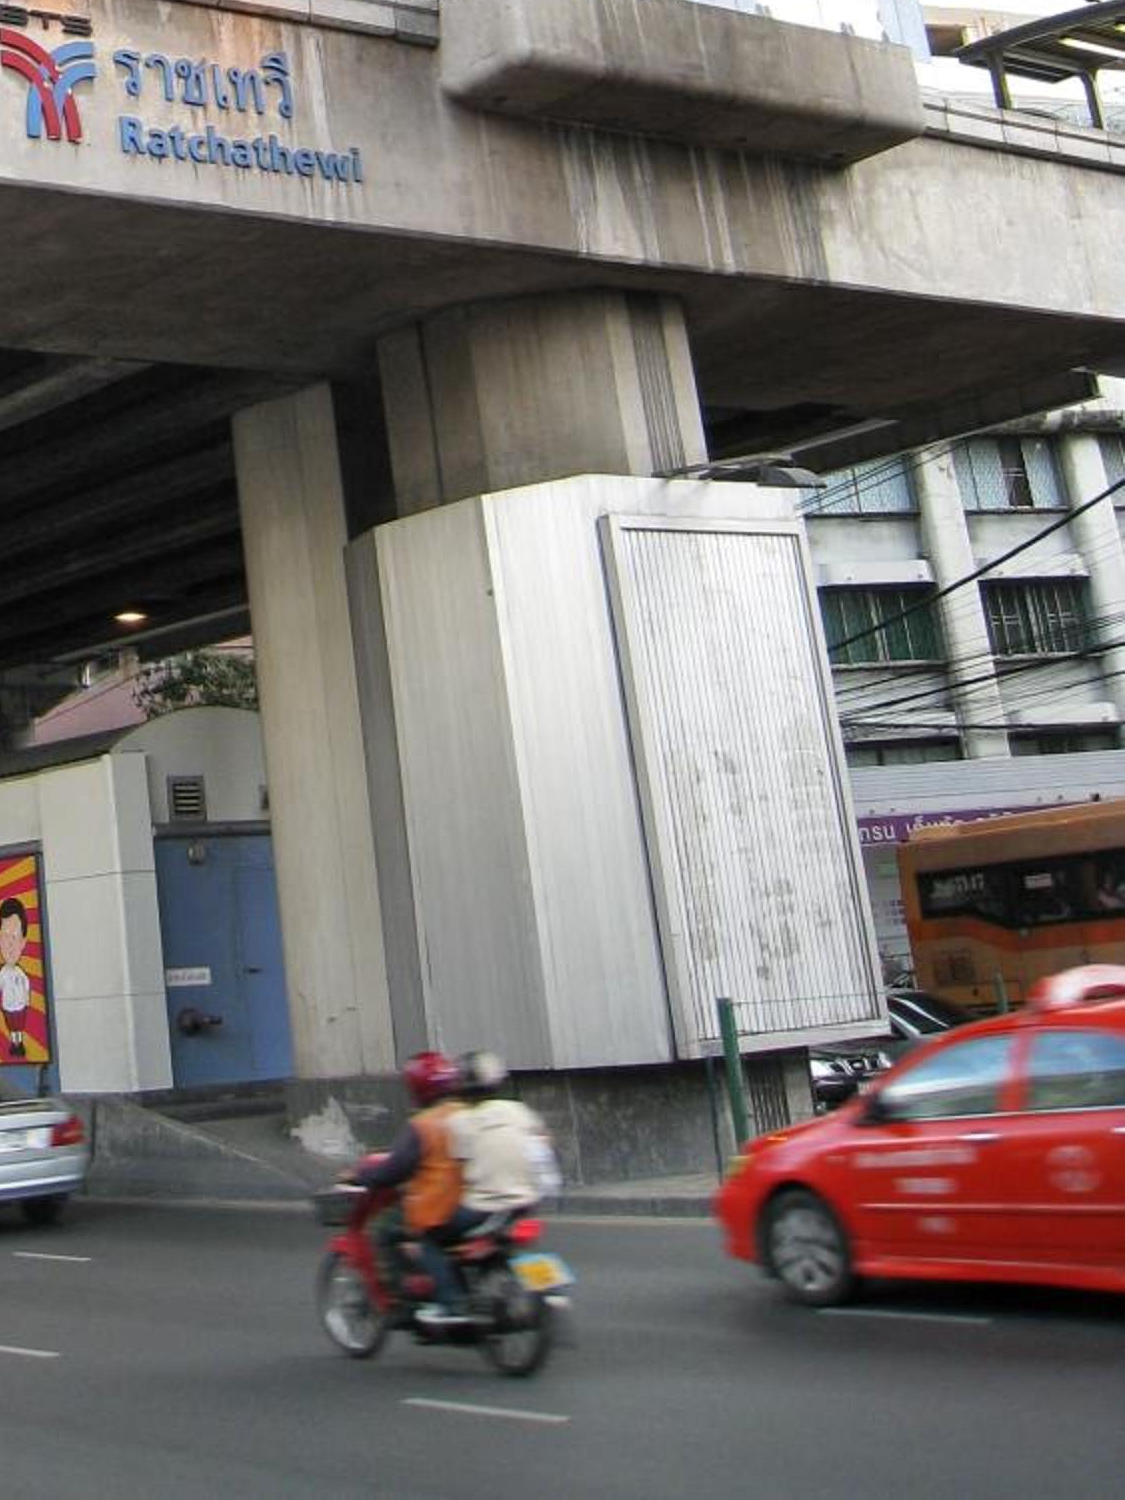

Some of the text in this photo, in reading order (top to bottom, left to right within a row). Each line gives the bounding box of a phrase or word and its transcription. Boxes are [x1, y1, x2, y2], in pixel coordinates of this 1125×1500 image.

[112, 48, 295, 120] ราชเทวี
[118, 115, 364, 184] Ratchathewi
